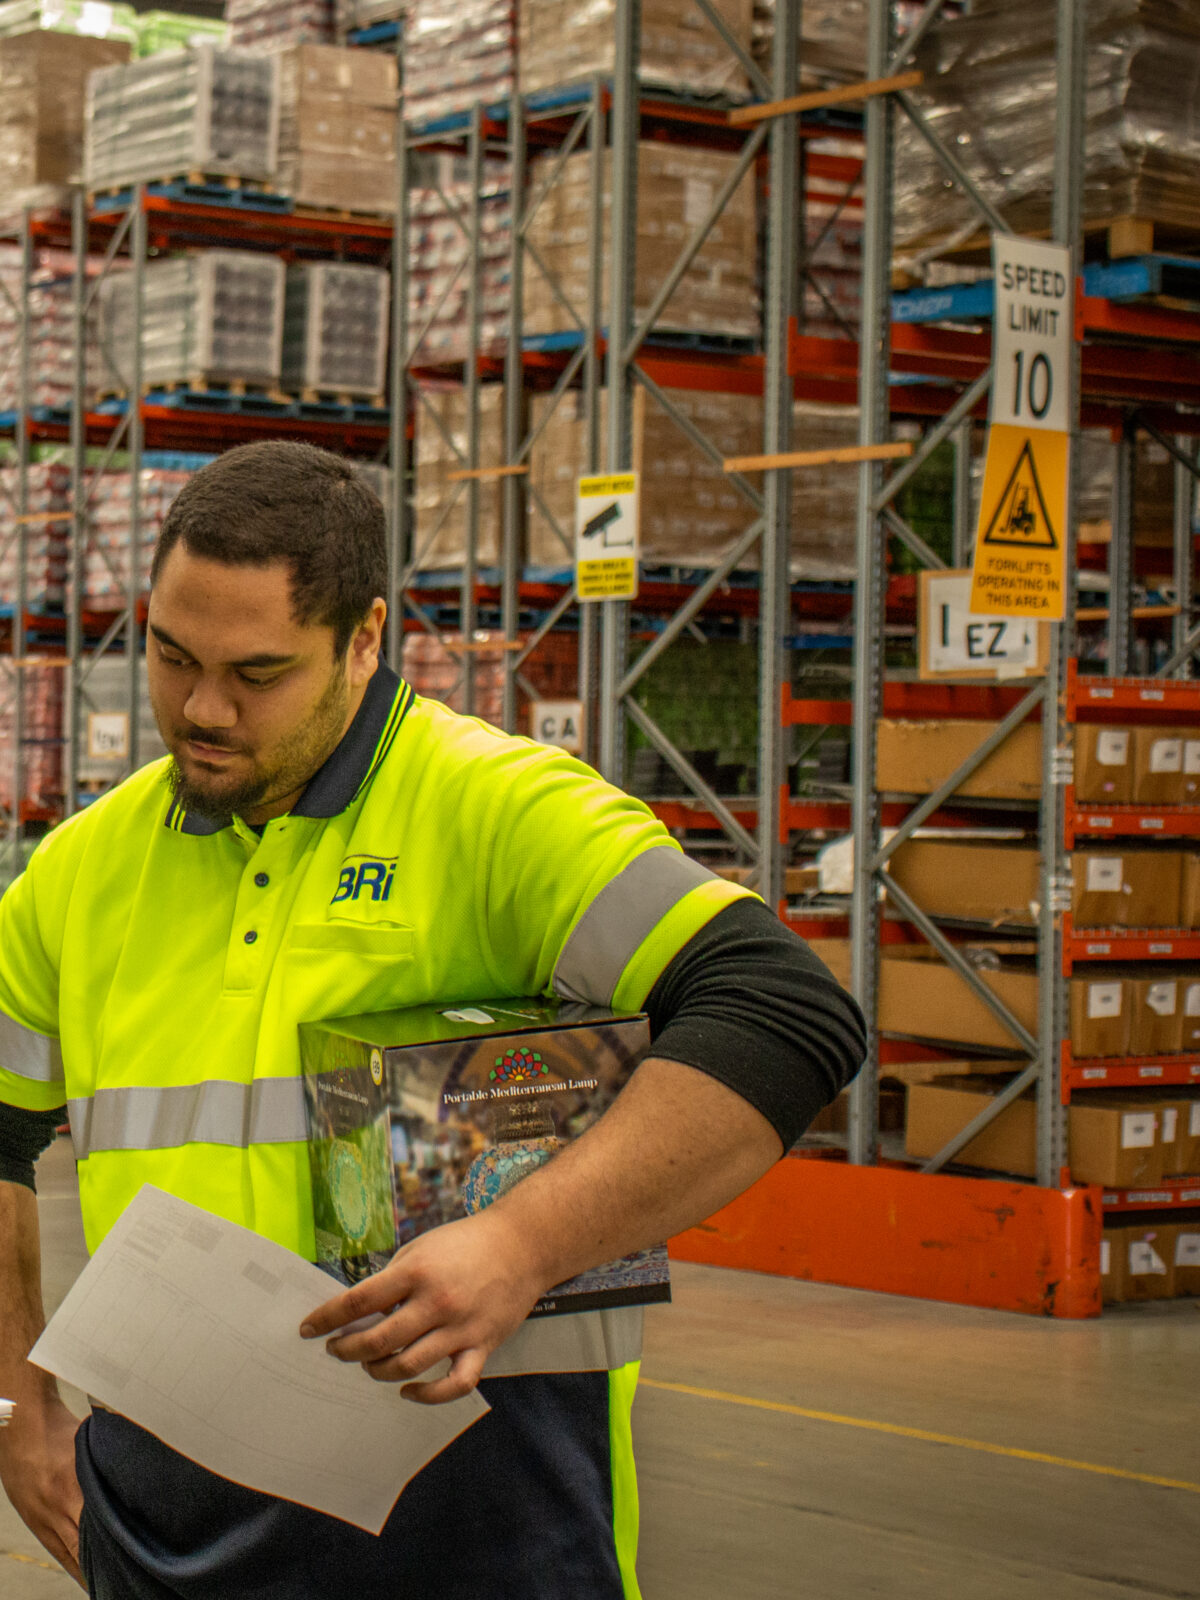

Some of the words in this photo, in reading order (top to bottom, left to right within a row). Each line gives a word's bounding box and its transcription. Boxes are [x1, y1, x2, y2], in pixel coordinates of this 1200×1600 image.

[1001, 263, 1066, 299] SPEED
[1008, 303, 1060, 337] LIMIT
[1013, 350, 1053, 419] 10
[987, 558, 1052, 575] FORKLIFTS
[977, 575, 1044, 591] OPERATING
[1047, 580, 1060, 592] IN
[986, 593, 1012, 607] THIS
[1015, 597, 1050, 609] AREA
[967, 621, 1008, 659] EZ
[443, 1090, 489, 1105] Portable
[490, 1081, 567, 1099] Mediterranean
[568, 1078, 599, 1091] Lamp
